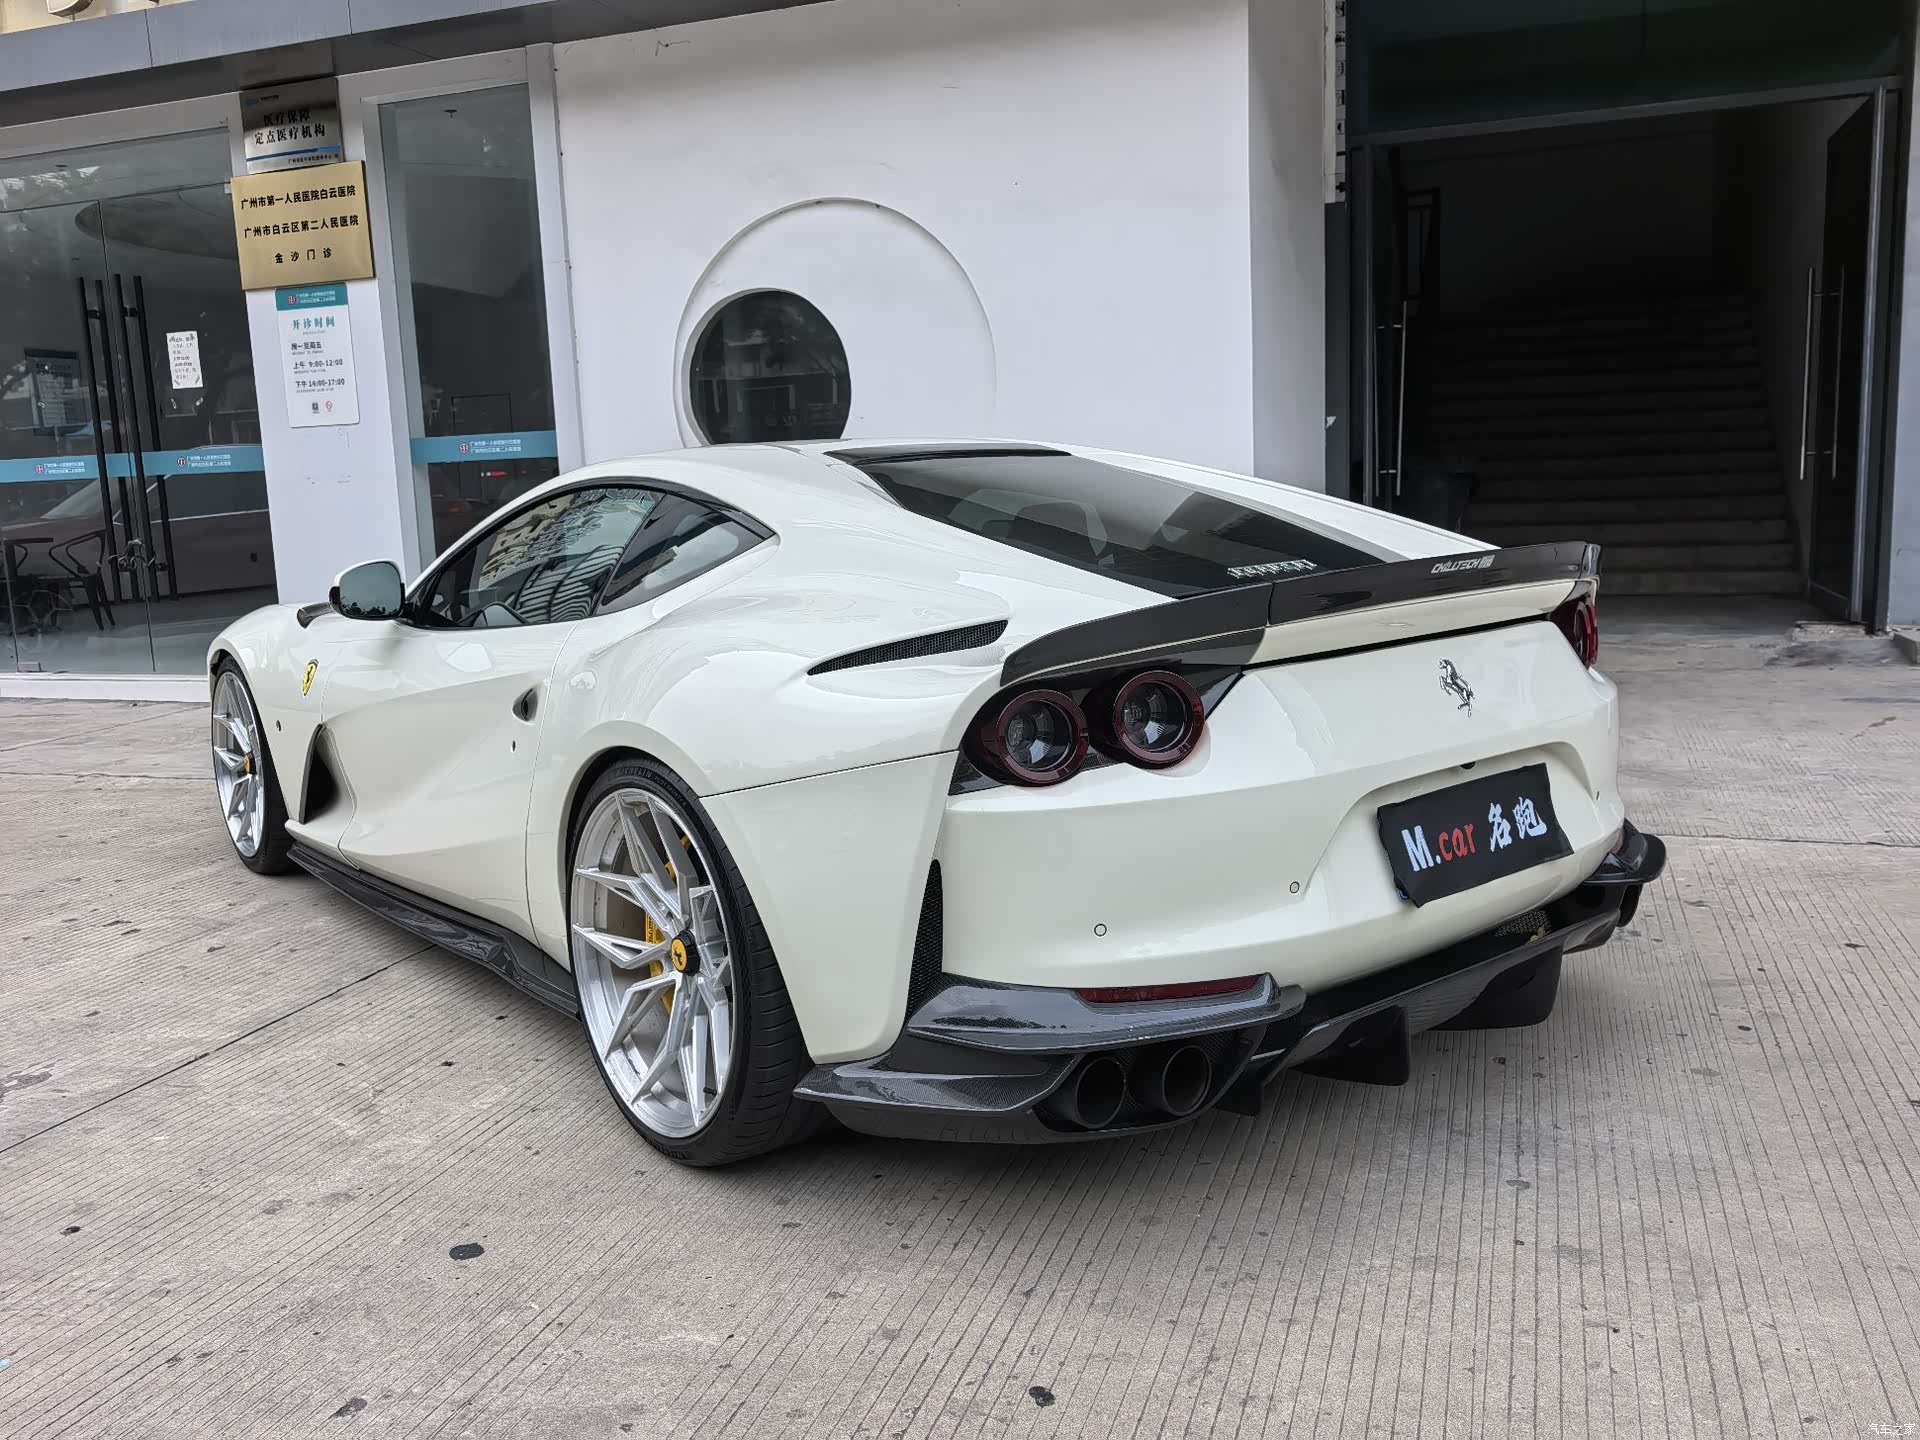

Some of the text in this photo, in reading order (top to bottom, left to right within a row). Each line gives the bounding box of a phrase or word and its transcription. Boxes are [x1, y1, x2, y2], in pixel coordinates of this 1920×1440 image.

[254, 123, 326, 145] 定点医疗机构
[241, 185, 356, 209] 广州市第一人民医院白云医院
[244, 214, 359, 239] 广州市白云区第二人民医院
[274, 247, 332, 264] 金沙门诊
